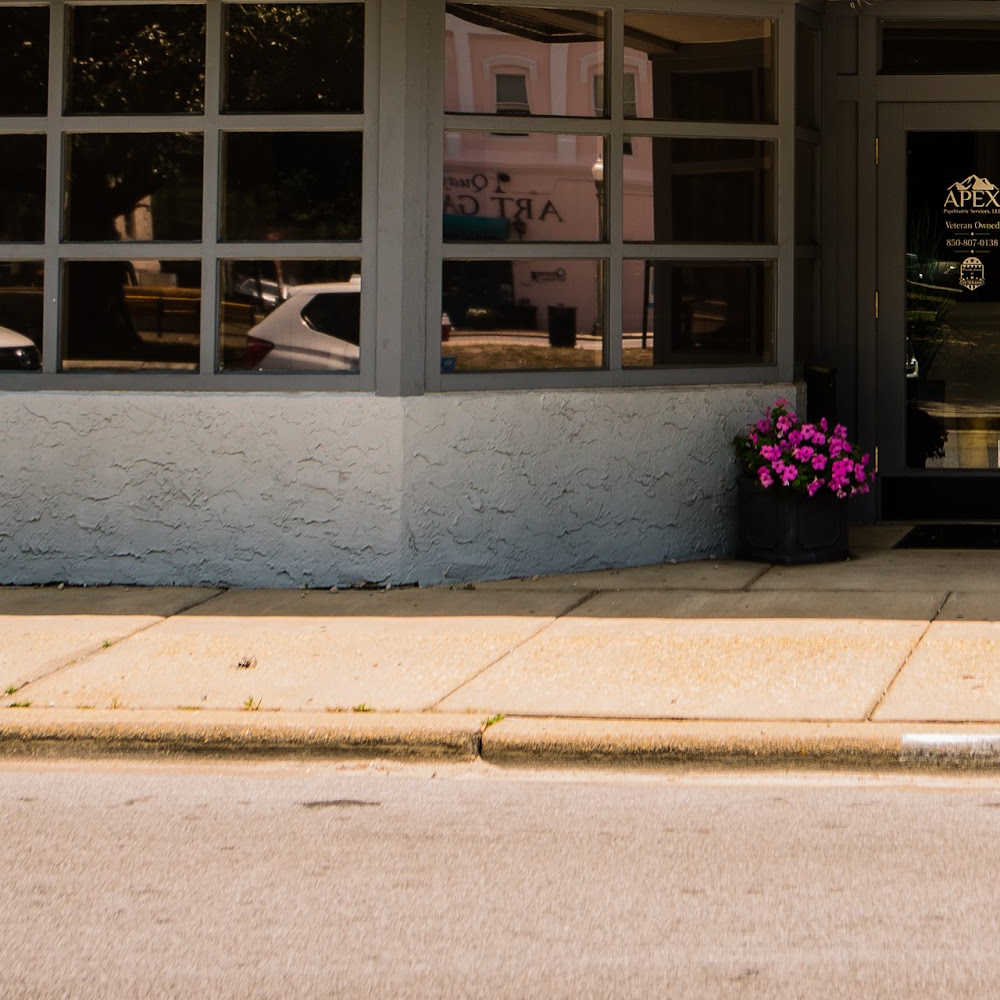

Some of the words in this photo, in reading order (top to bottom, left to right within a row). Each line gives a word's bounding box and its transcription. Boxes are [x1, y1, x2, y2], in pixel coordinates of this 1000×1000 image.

[943, 190, 1000, 207] APEX
[945, 221, 973, 229] Veteran
[974, 221, 1000, 229] Owned
[946, 239, 999, 247] 850-807-0138
